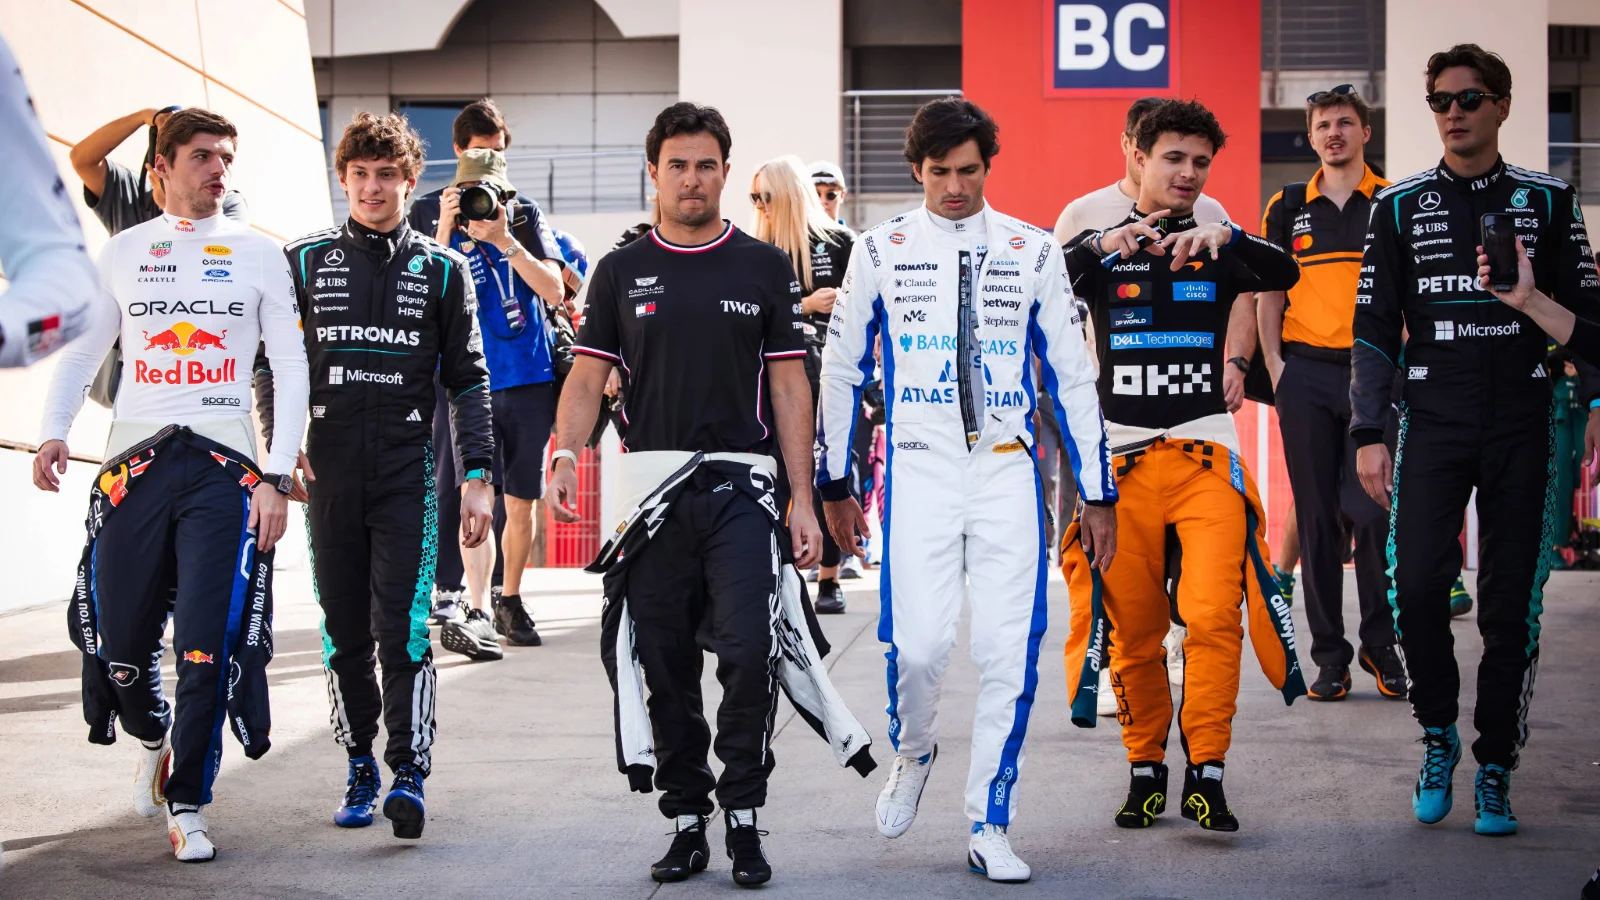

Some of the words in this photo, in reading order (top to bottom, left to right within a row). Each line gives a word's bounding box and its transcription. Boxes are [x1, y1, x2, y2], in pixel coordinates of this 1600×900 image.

[1058, 3, 1165, 71] BC
[185, 225, 196, 233] Bull
[1425, 222, 1449, 233] UBS
[1421, 252, 1454, 261] Snapdragon
[139, 264, 165, 273] Mobil
[167, 265, 177, 273] 1
[894, 262, 938, 271] KOMATSU
[1112, 262, 1150, 272] Android
[327, 278, 348, 287] UBS
[397, 280, 429, 294] INEOS
[628, 285, 665, 295] CADILLAC
[904, 278, 937, 288] Claude
[1417, 275, 1487, 294] PETRO
[128, 299, 245, 317] ORACLE
[398, 307, 424, 319] HPE
[720, 300, 751, 315] TWG
[315, 325, 420, 347] PETRONAS
[1457, 321, 1521, 337] Microsoft
[1113, 334, 1143, 346] DELL
[1144, 333, 1212, 347] Technologies
[135, 359, 182, 385] Red
[187, 358, 236, 385] Bull
[346, 369, 404, 385] Microsoft
[201, 396, 240, 406] sparco
[256, 562, 268, 591] GIVES
[252, 591, 266, 612] YOU
[78, 603, 90, 625] YOU
[246, 613, 263, 647] WINGS
[1271, 594, 1296, 651] allwyn
[83, 626, 96, 655] GIVES
[994, 767, 1014, 806] sparco
